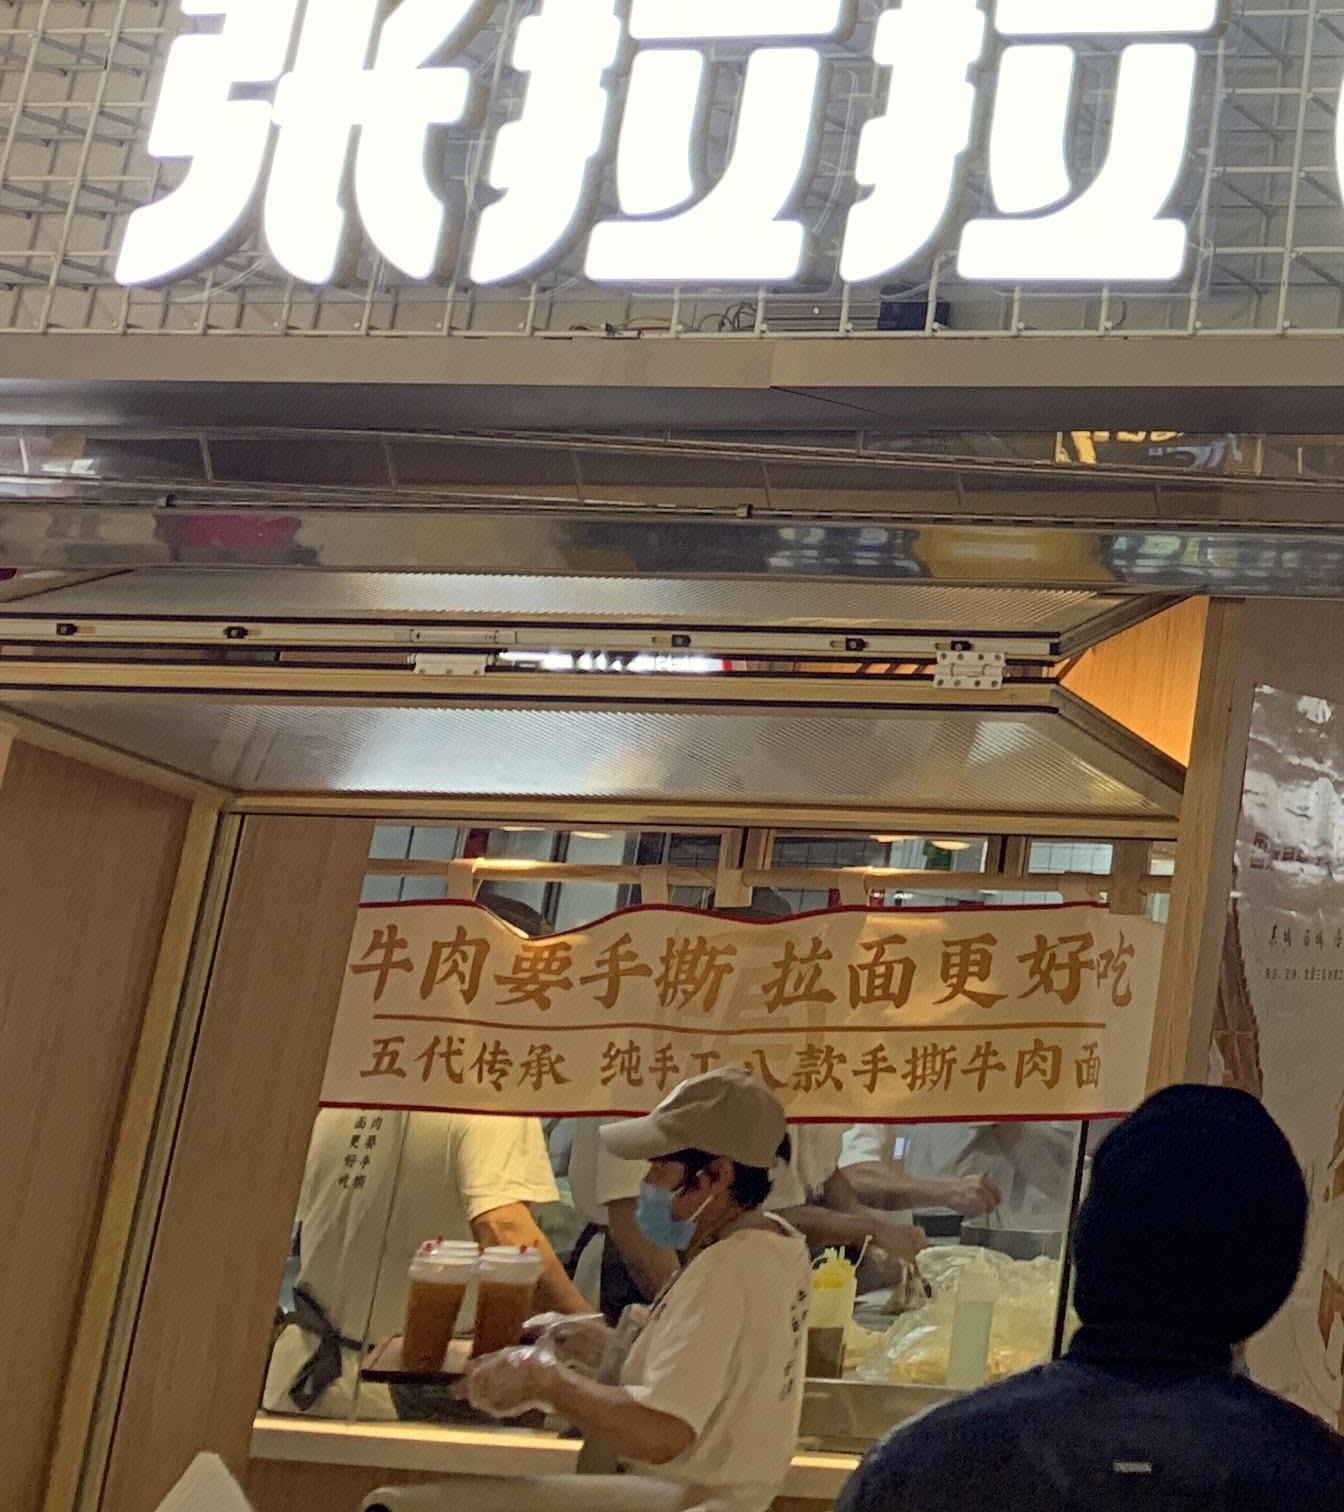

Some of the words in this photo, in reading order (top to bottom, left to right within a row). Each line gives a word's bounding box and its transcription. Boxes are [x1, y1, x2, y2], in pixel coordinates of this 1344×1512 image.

[350, 923, 738, 1013] 牛肉要手撕
[761, 930, 1136, 1014] 拉面更好吃
[359, 1035, 572, 1093] 五代传承
